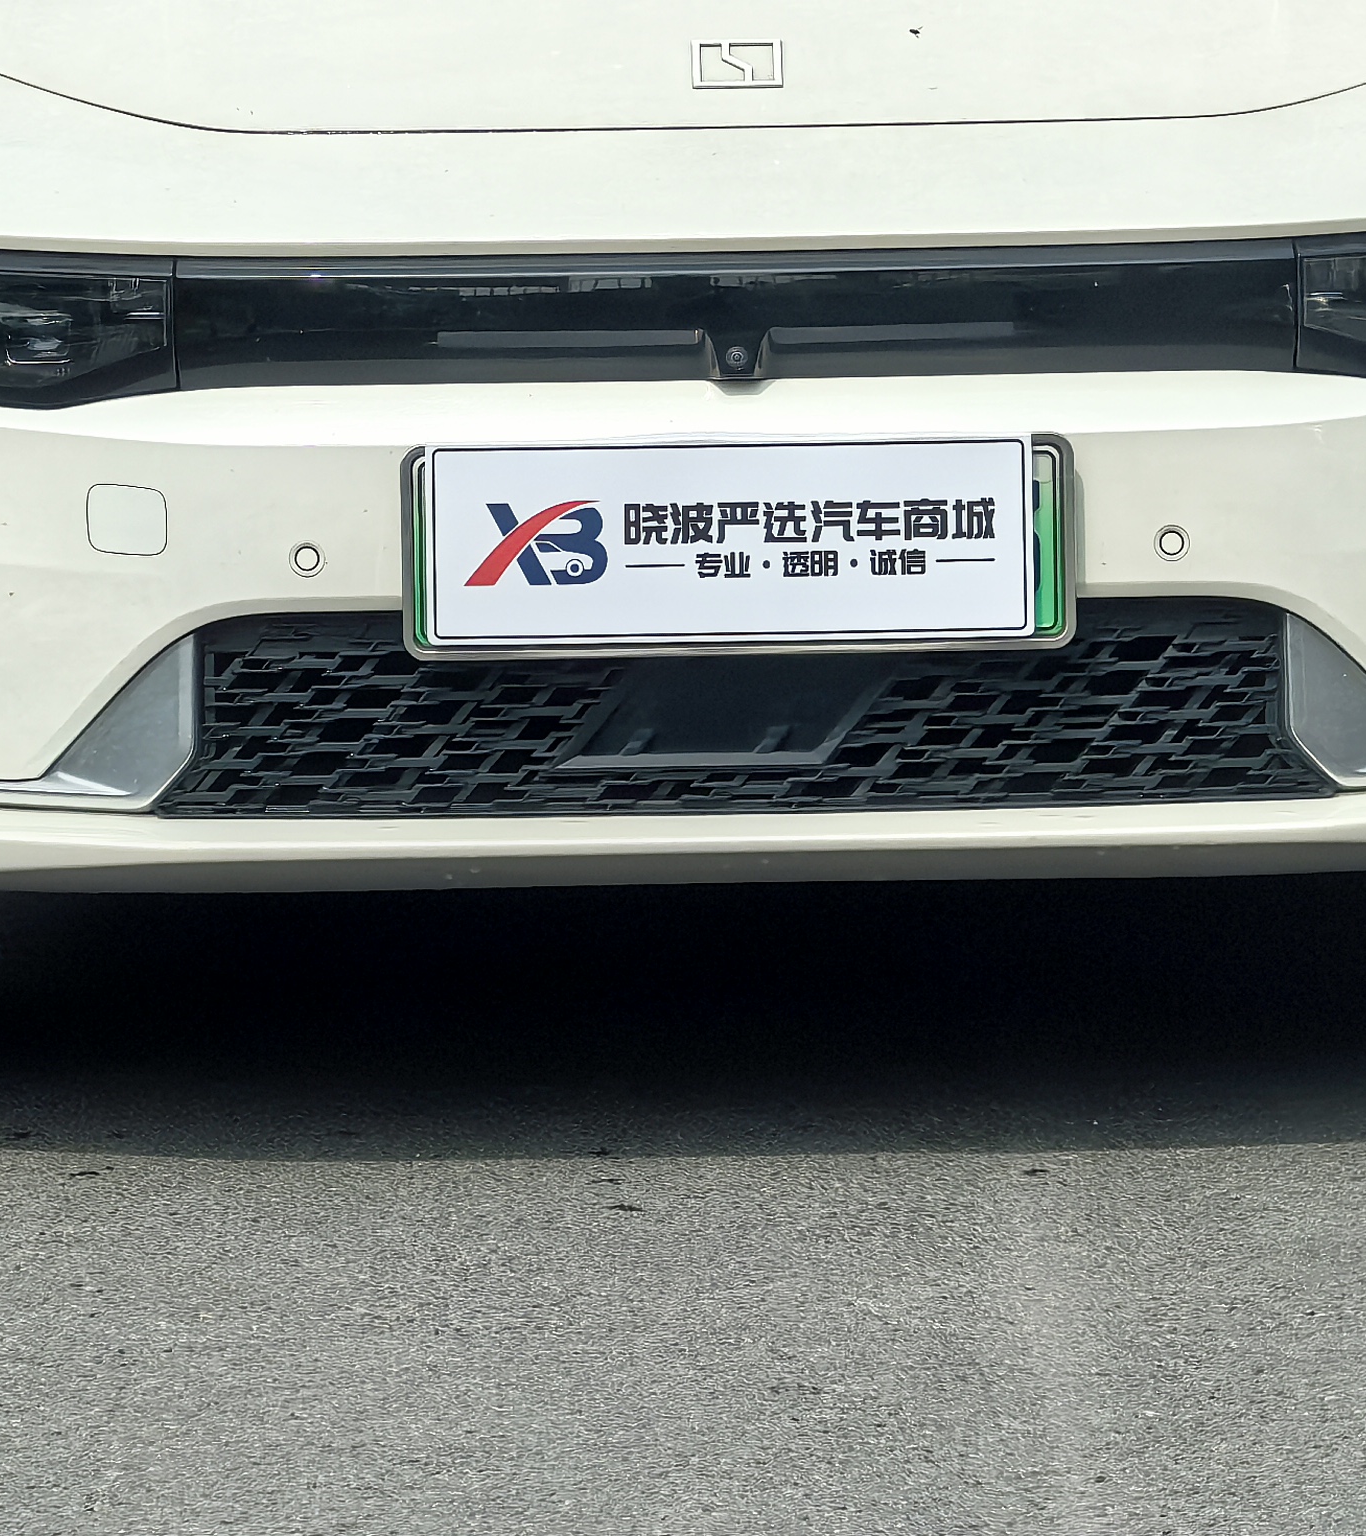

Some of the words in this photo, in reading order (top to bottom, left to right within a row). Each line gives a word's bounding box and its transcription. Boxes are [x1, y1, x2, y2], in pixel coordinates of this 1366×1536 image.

[623, 497, 996, 546] 晓波严选汽车商城
